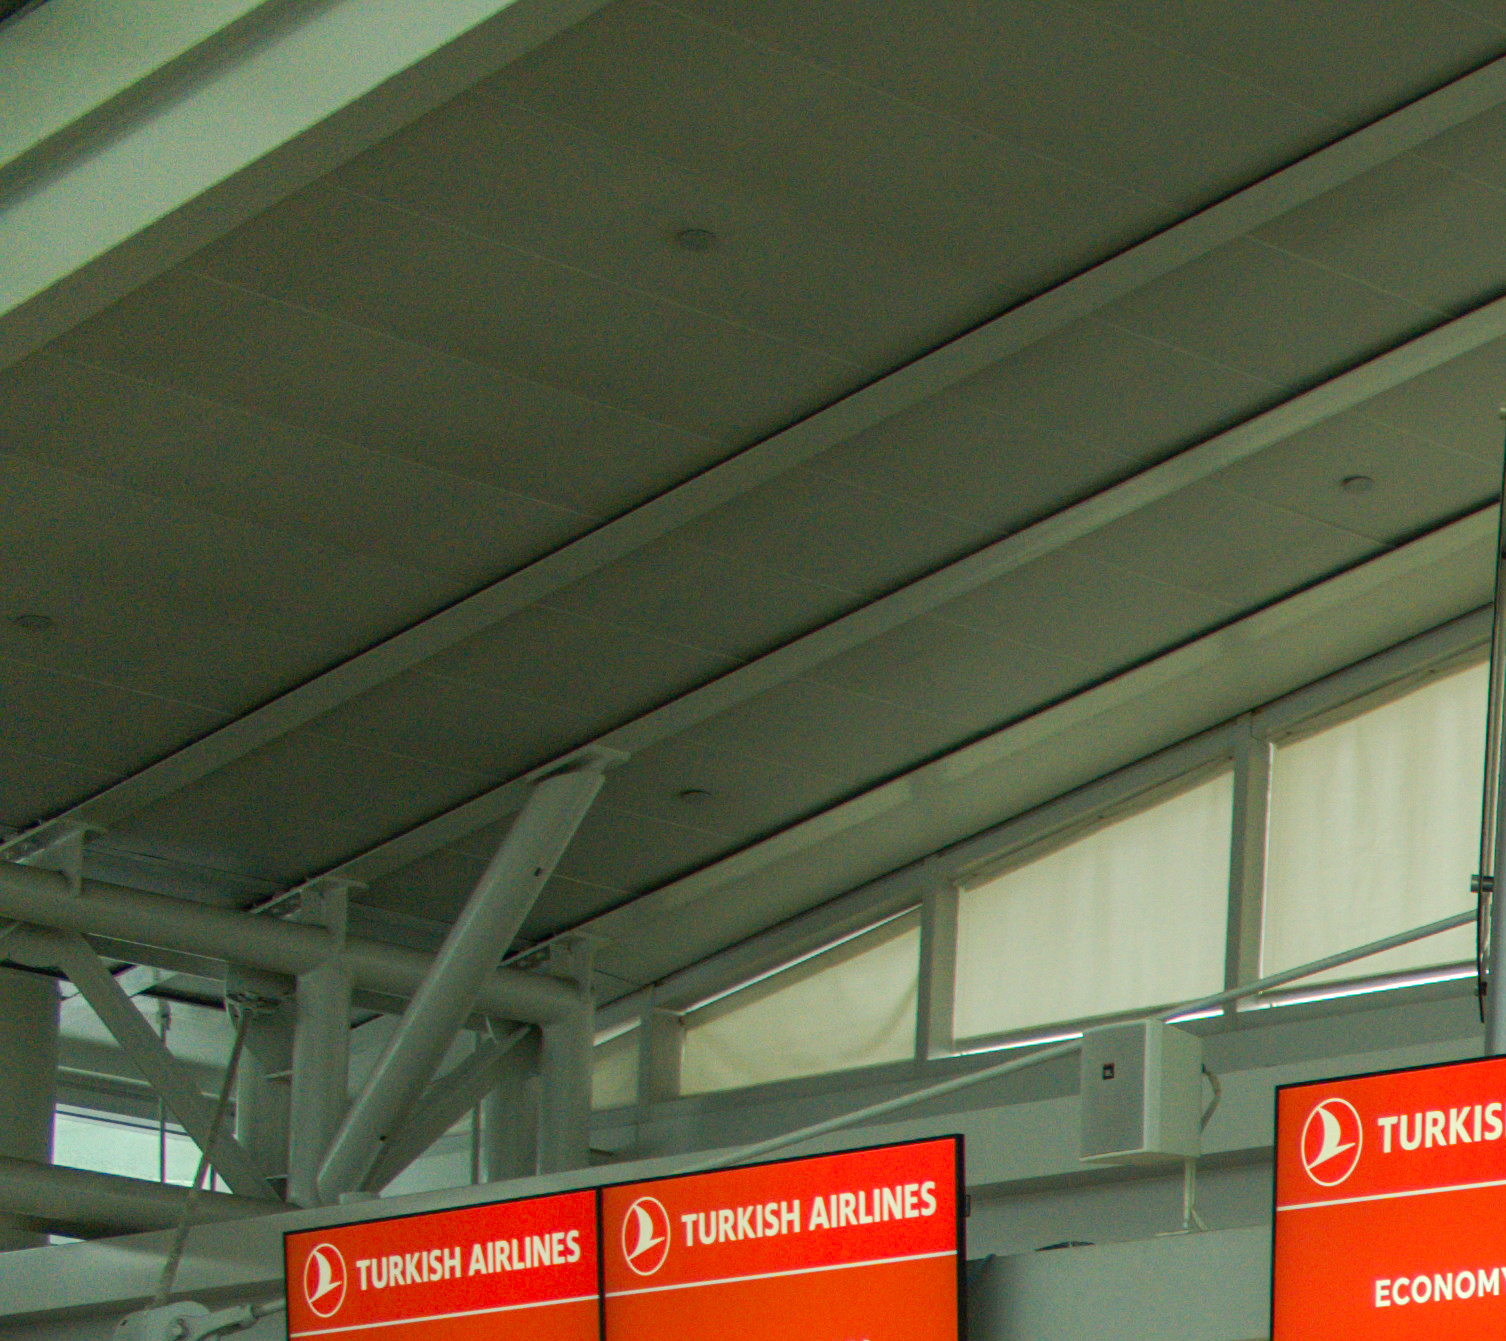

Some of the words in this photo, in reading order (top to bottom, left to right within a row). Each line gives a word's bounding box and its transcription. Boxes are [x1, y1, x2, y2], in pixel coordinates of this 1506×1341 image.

[681, 1202, 802, 1248] TURKISH
[808, 1181, 937, 1231] AIRLINES
[356, 1247, 462, 1292] TURKISH
[469, 1230, 581, 1277] AIRLINES
